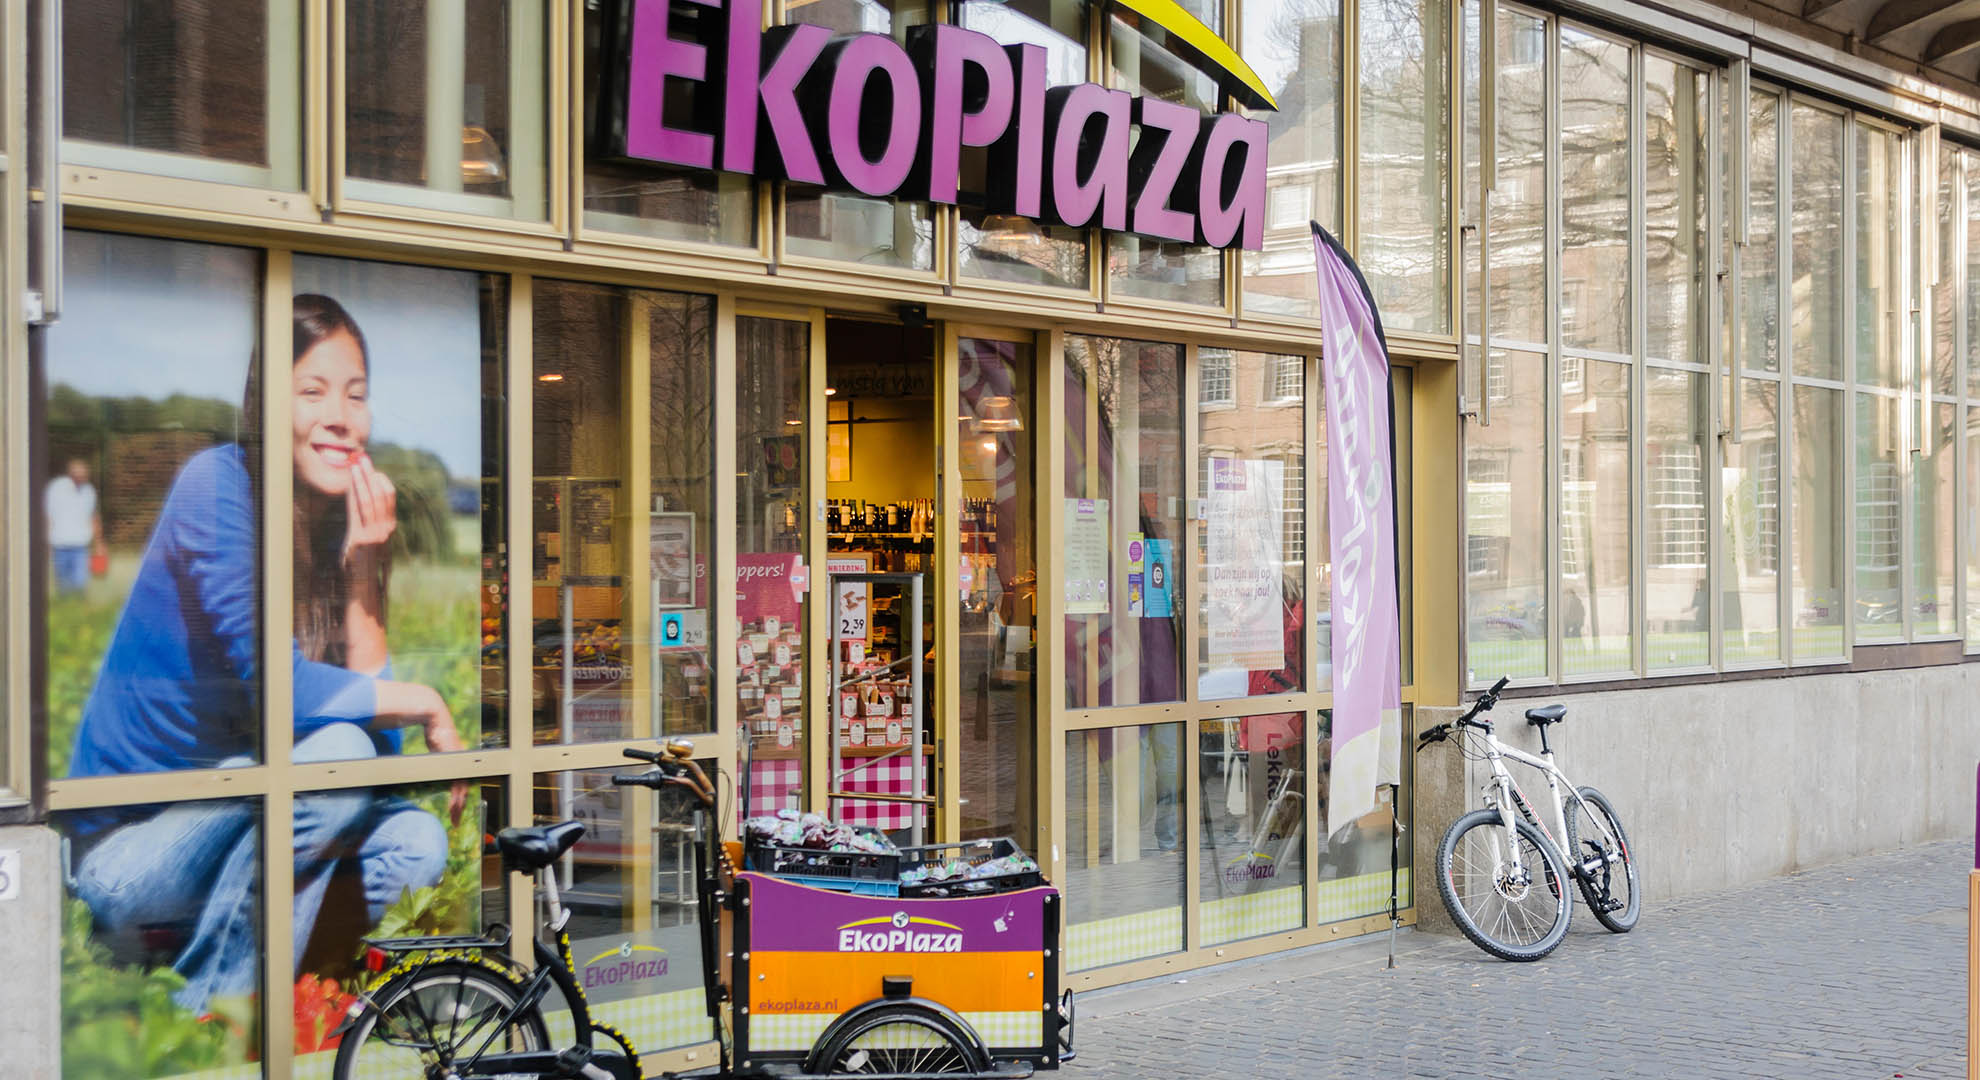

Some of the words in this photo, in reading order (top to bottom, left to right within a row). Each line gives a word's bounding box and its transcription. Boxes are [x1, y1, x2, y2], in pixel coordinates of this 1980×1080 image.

[626, 0, 1269, 252] EkoPlaza
[736, 563, 785, 582] ppers!
[827, 564, 865, 572] NBIEDING
[841, 618, 865, 635] 2.39
[1266, 733, 1283, 807] Lekke
[1226, 863, 1275, 882] EkoPlaza
[838, 929, 963, 953] EkoPlaza
[584, 957, 669, 988] EkoPlaza
[758, 999, 839, 1014] ekoplaza.nl
